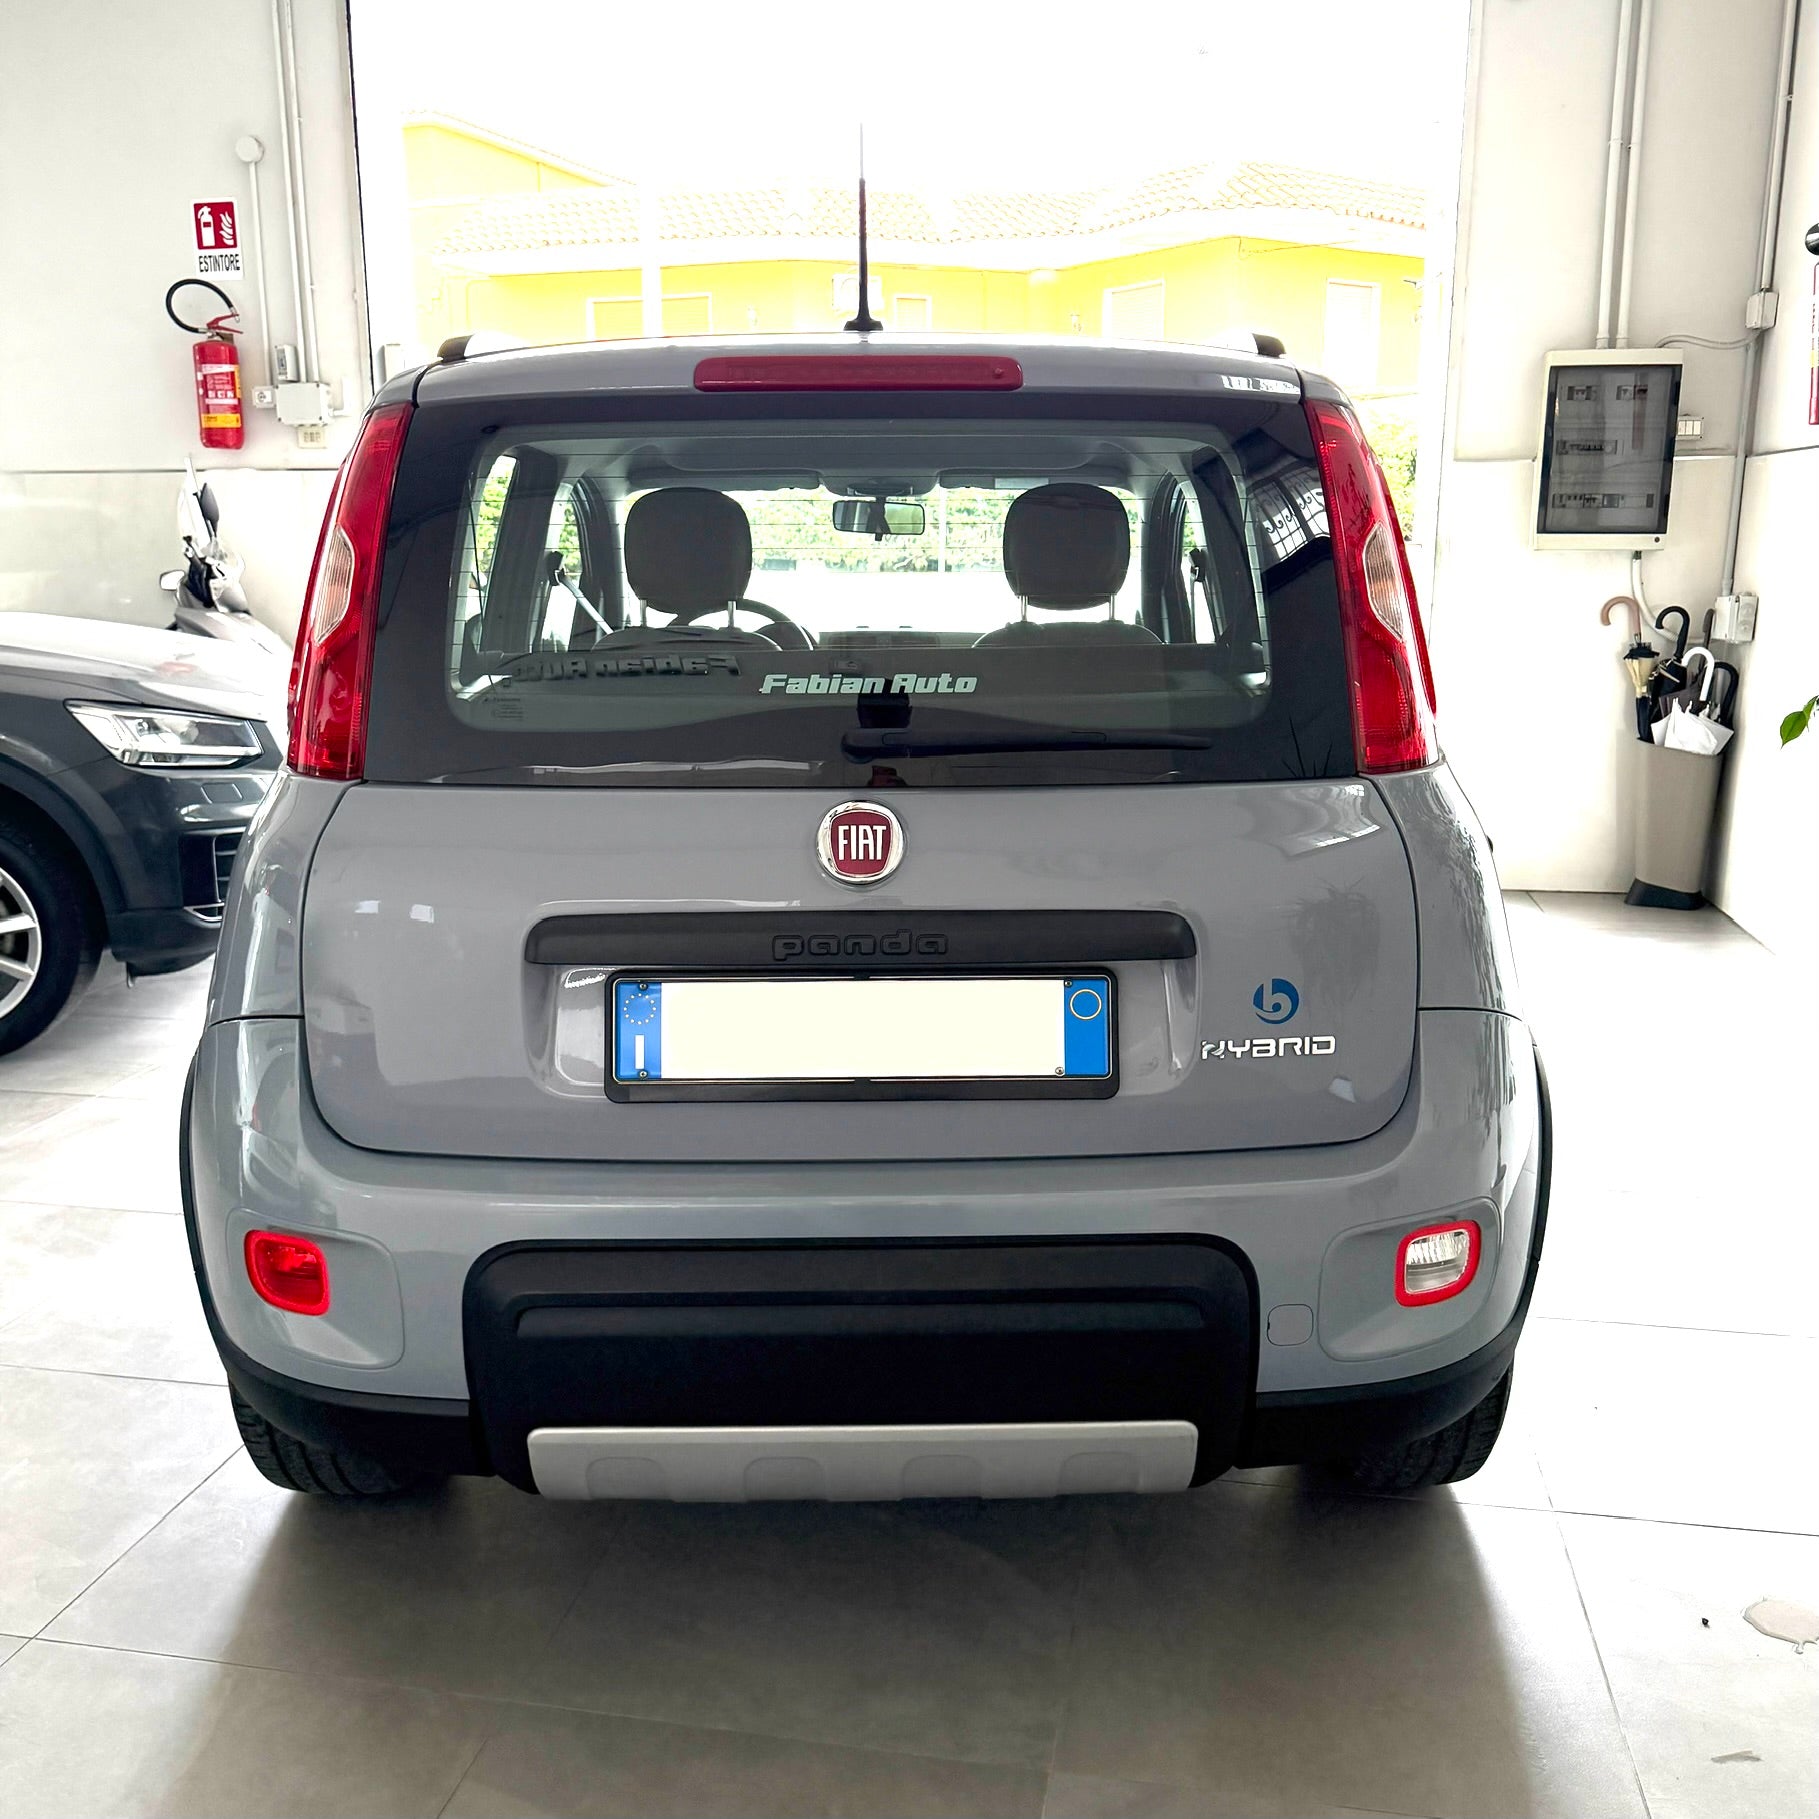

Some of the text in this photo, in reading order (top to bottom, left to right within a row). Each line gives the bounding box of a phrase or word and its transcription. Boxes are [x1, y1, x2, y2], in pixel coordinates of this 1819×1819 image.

[199, 254, 241, 273] ESTINTORE
[759, 673, 977, 694] Fabian Auto
[838, 825, 887, 860] FIAT
[772, 928, 948, 962] panda
[635, 1035, 645, 1069] I
[1201, 1035, 1336, 1060] HYBRID
